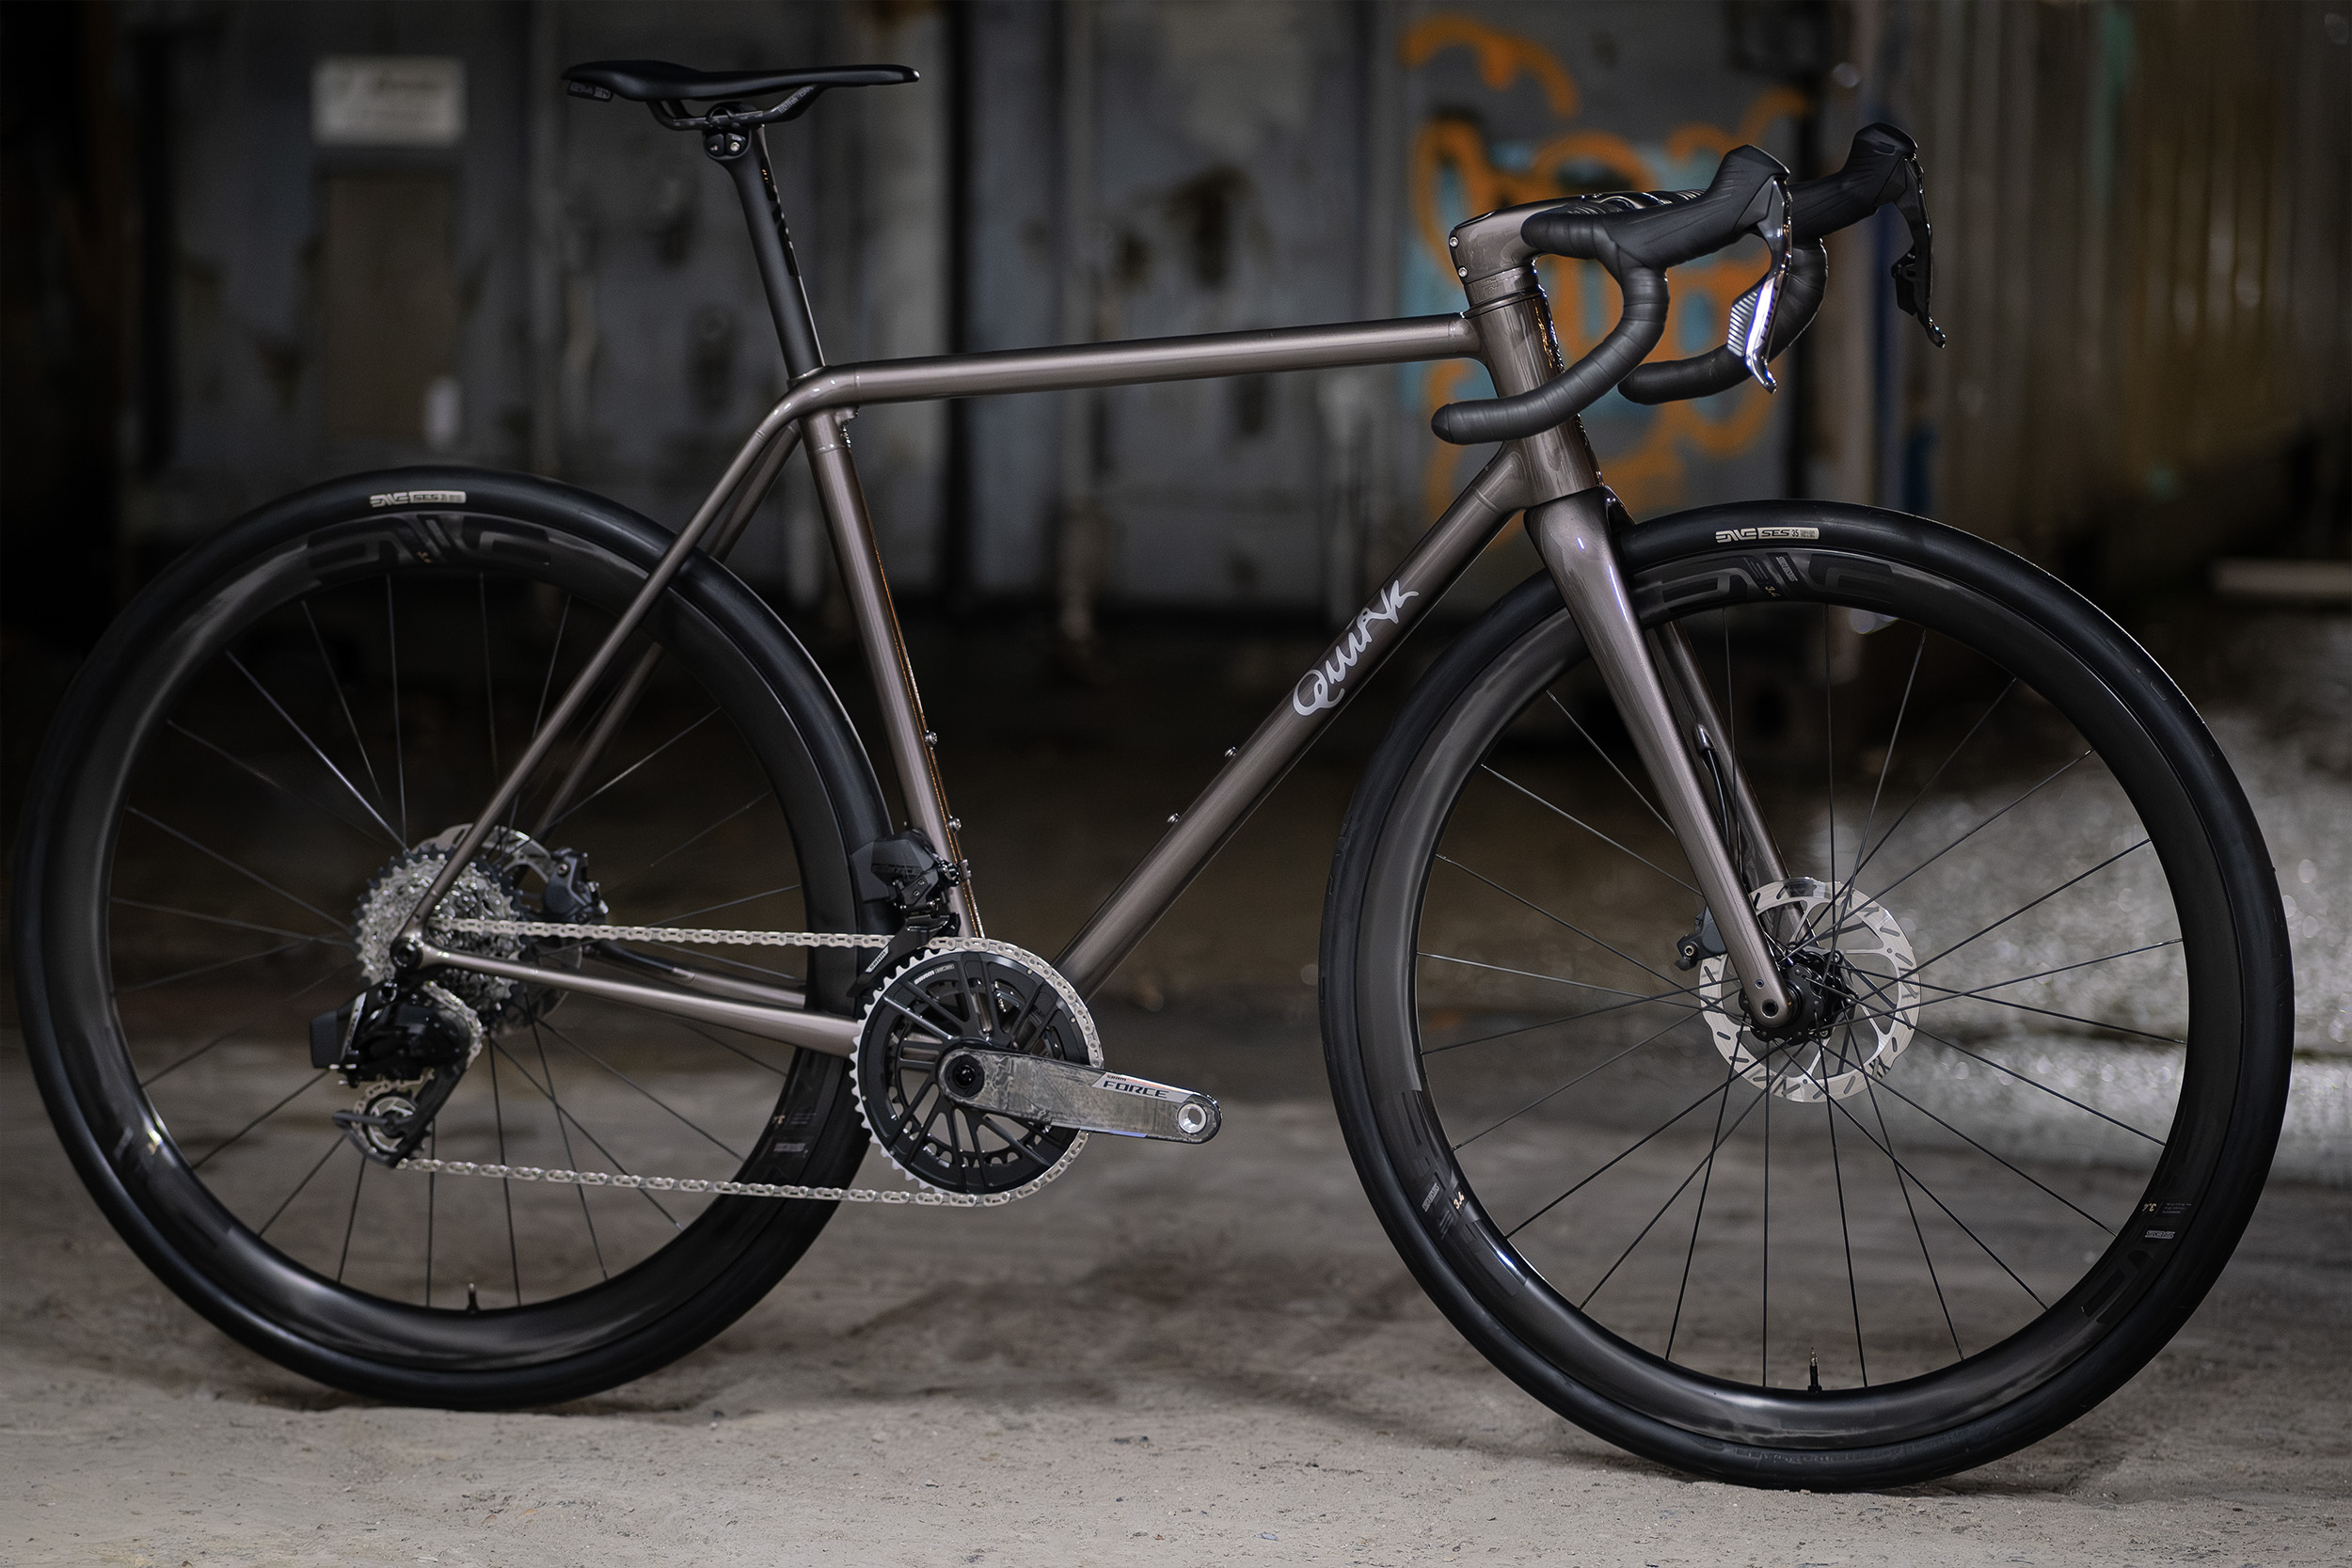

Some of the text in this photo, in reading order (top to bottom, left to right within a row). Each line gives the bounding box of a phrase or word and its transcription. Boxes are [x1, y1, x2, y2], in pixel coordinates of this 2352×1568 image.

[1715, 528, 1757, 544] ENVE
[1761, 529, 1790, 537] SES
[1791, 529, 1799, 538] 35
[1104, 1080, 1169, 1099] FORCE
[1452, 1191, 1465, 1210] 3.4
